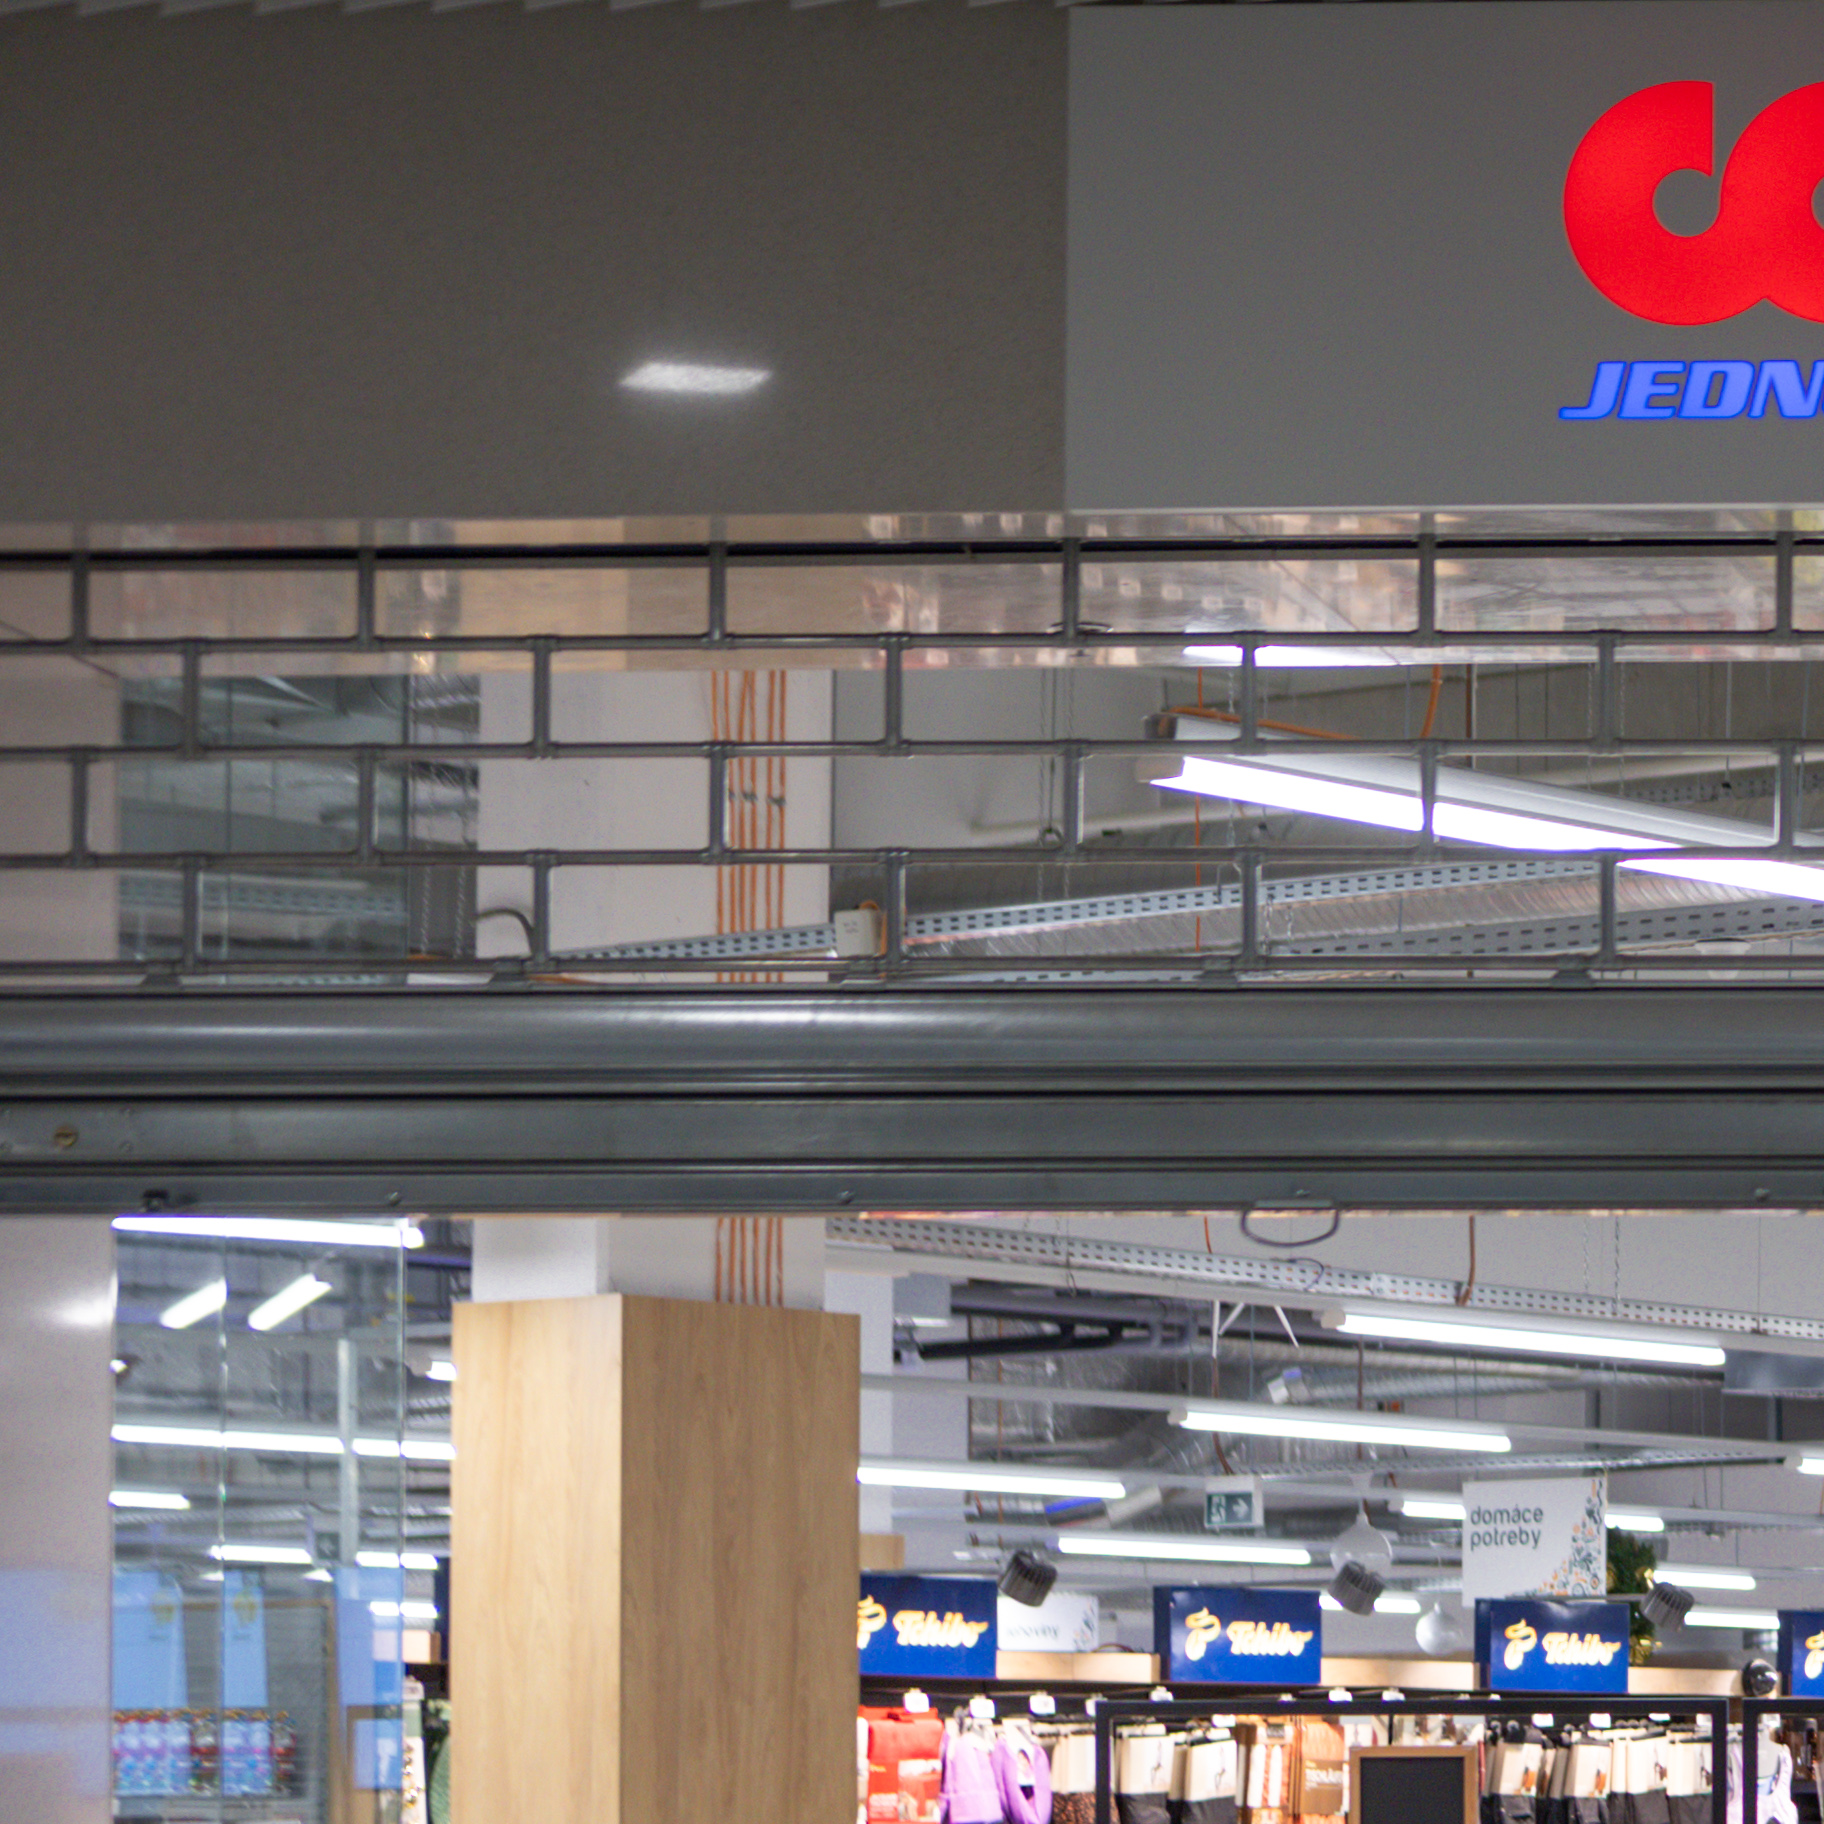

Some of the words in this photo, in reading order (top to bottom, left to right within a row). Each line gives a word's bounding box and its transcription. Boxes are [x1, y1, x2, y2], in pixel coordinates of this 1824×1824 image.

[1470, 1503, 1544, 1526] domáce
[1470, 1527, 1542, 1551] potreby
[892, 1610, 989, 1649] Tchibo
[1226, 1620, 1314, 1657] Tchibo
[1542, 1632, 1622, 1666] Tchibo
